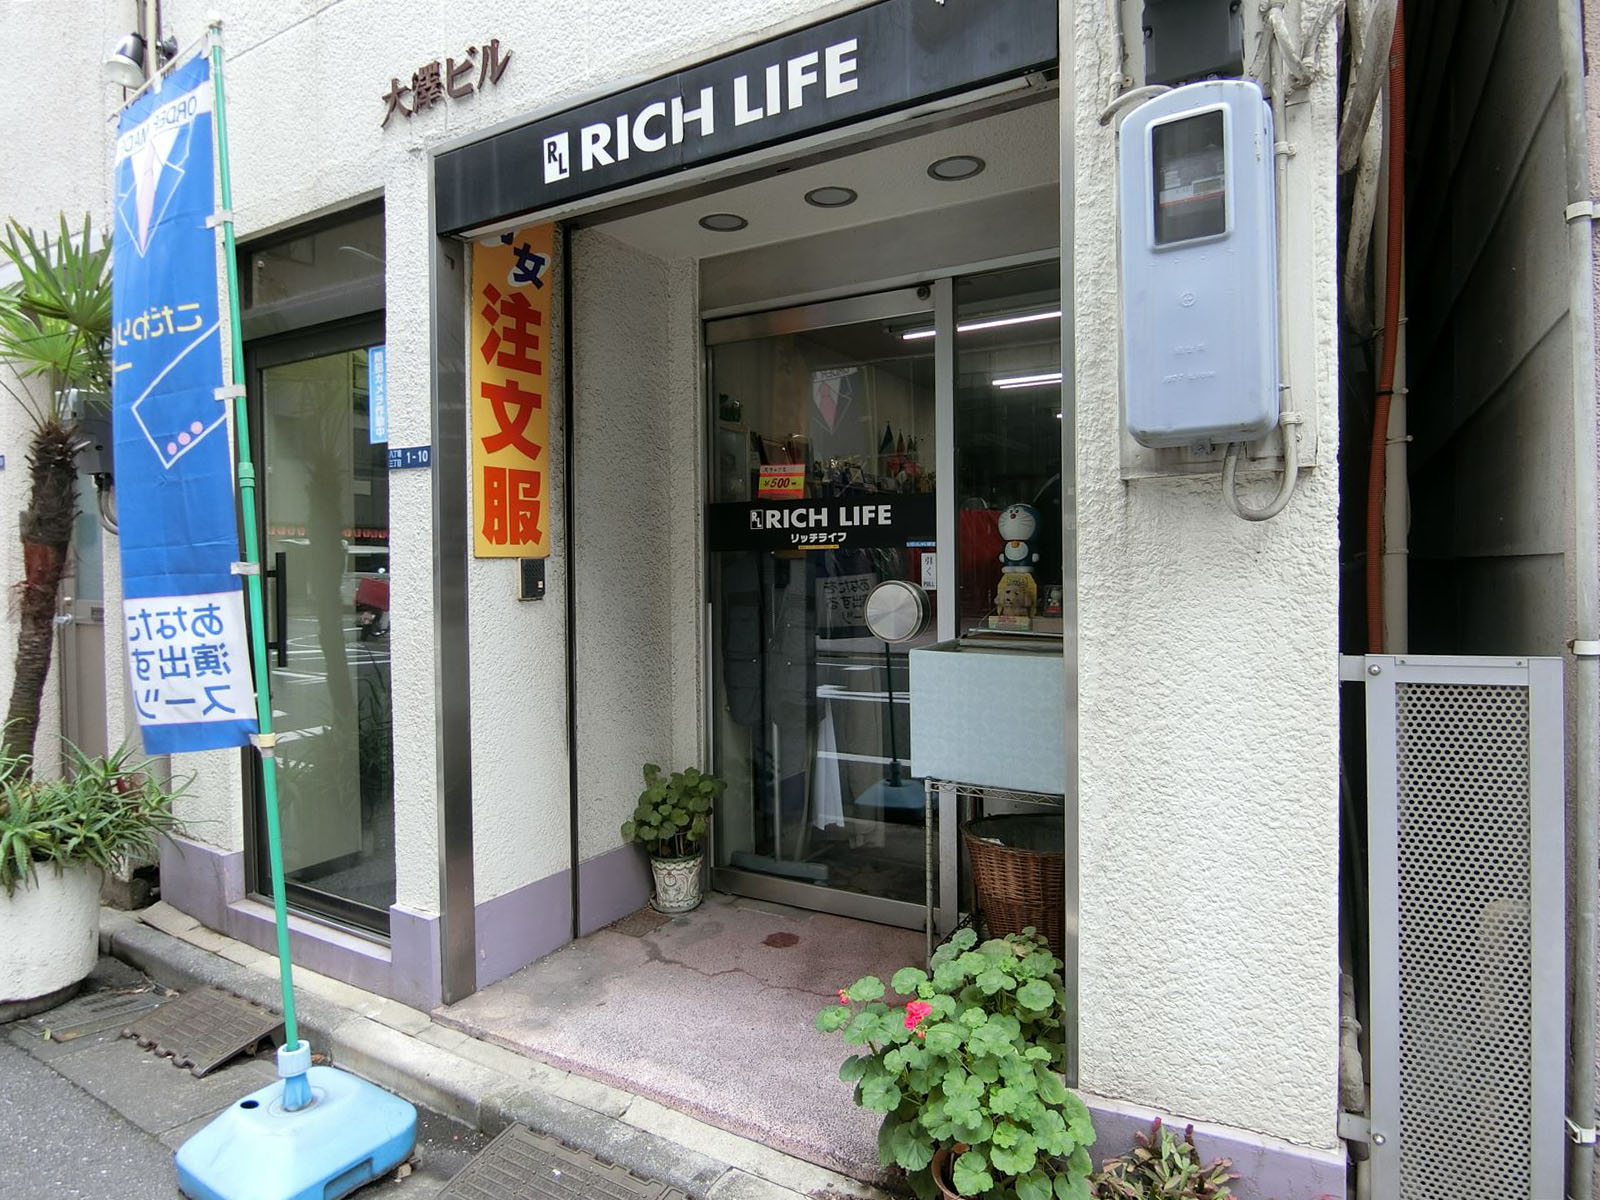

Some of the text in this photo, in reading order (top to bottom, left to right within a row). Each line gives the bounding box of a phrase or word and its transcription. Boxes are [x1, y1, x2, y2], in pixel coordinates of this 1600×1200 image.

[580, 87, 715, 172] RICH
[734, 38, 858, 127] LIFE
[479, 283, 543, 545] 注文服
[406, 450, 429, 464] 1-10
[766, 507, 828, 529] RICH
[839, 504, 892, 526] LIFE
[791, 532, 848, 543] リッチライフ
[924, 556, 933, 577] 引く
